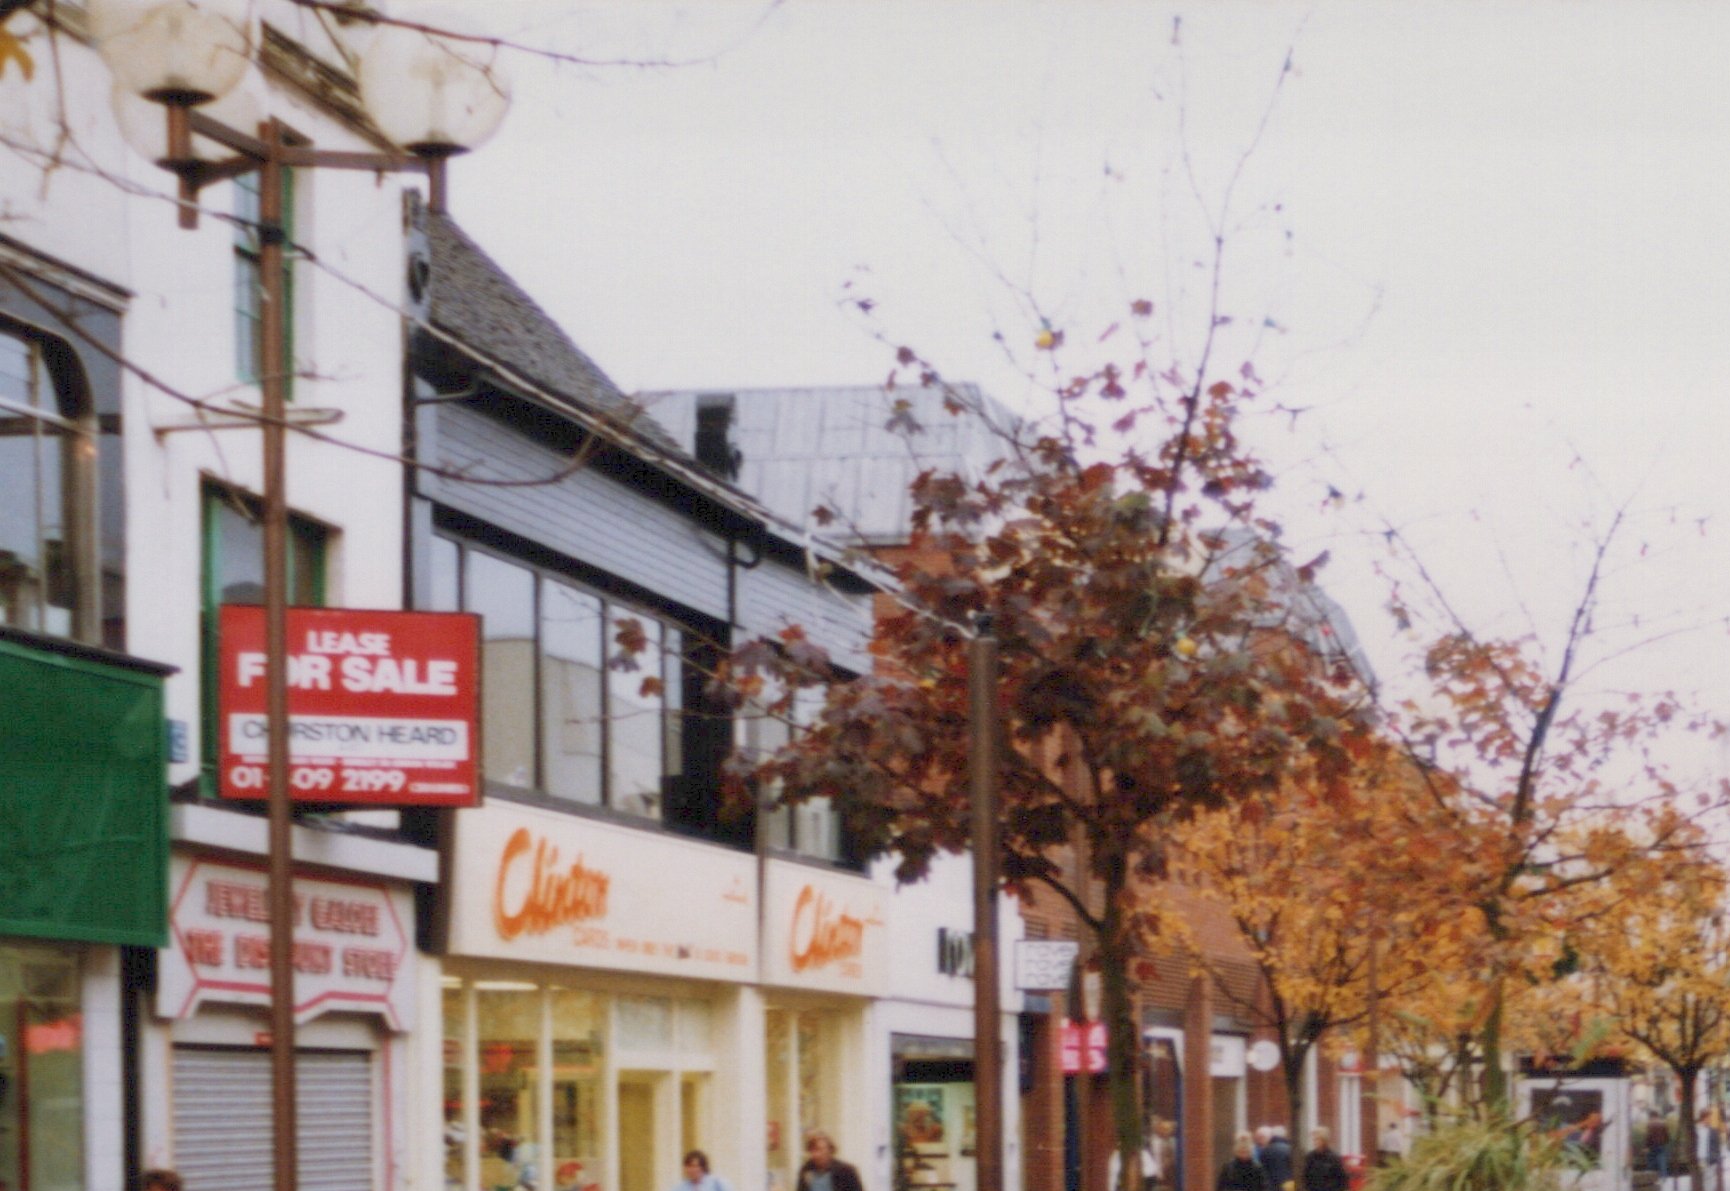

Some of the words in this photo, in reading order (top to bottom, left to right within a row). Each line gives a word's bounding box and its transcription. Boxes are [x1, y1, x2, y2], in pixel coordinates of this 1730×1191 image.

[306, 631, 392, 656] LEASE
[341, 655, 457, 696] SALE
[243, 720, 370, 750] CHRSTON
[378, 725, 458, 747] HEARD
[341, 769, 406, 793] 2199
[494, 826, 611, 941] Clinton
[791, 883, 865, 973] Clinton
